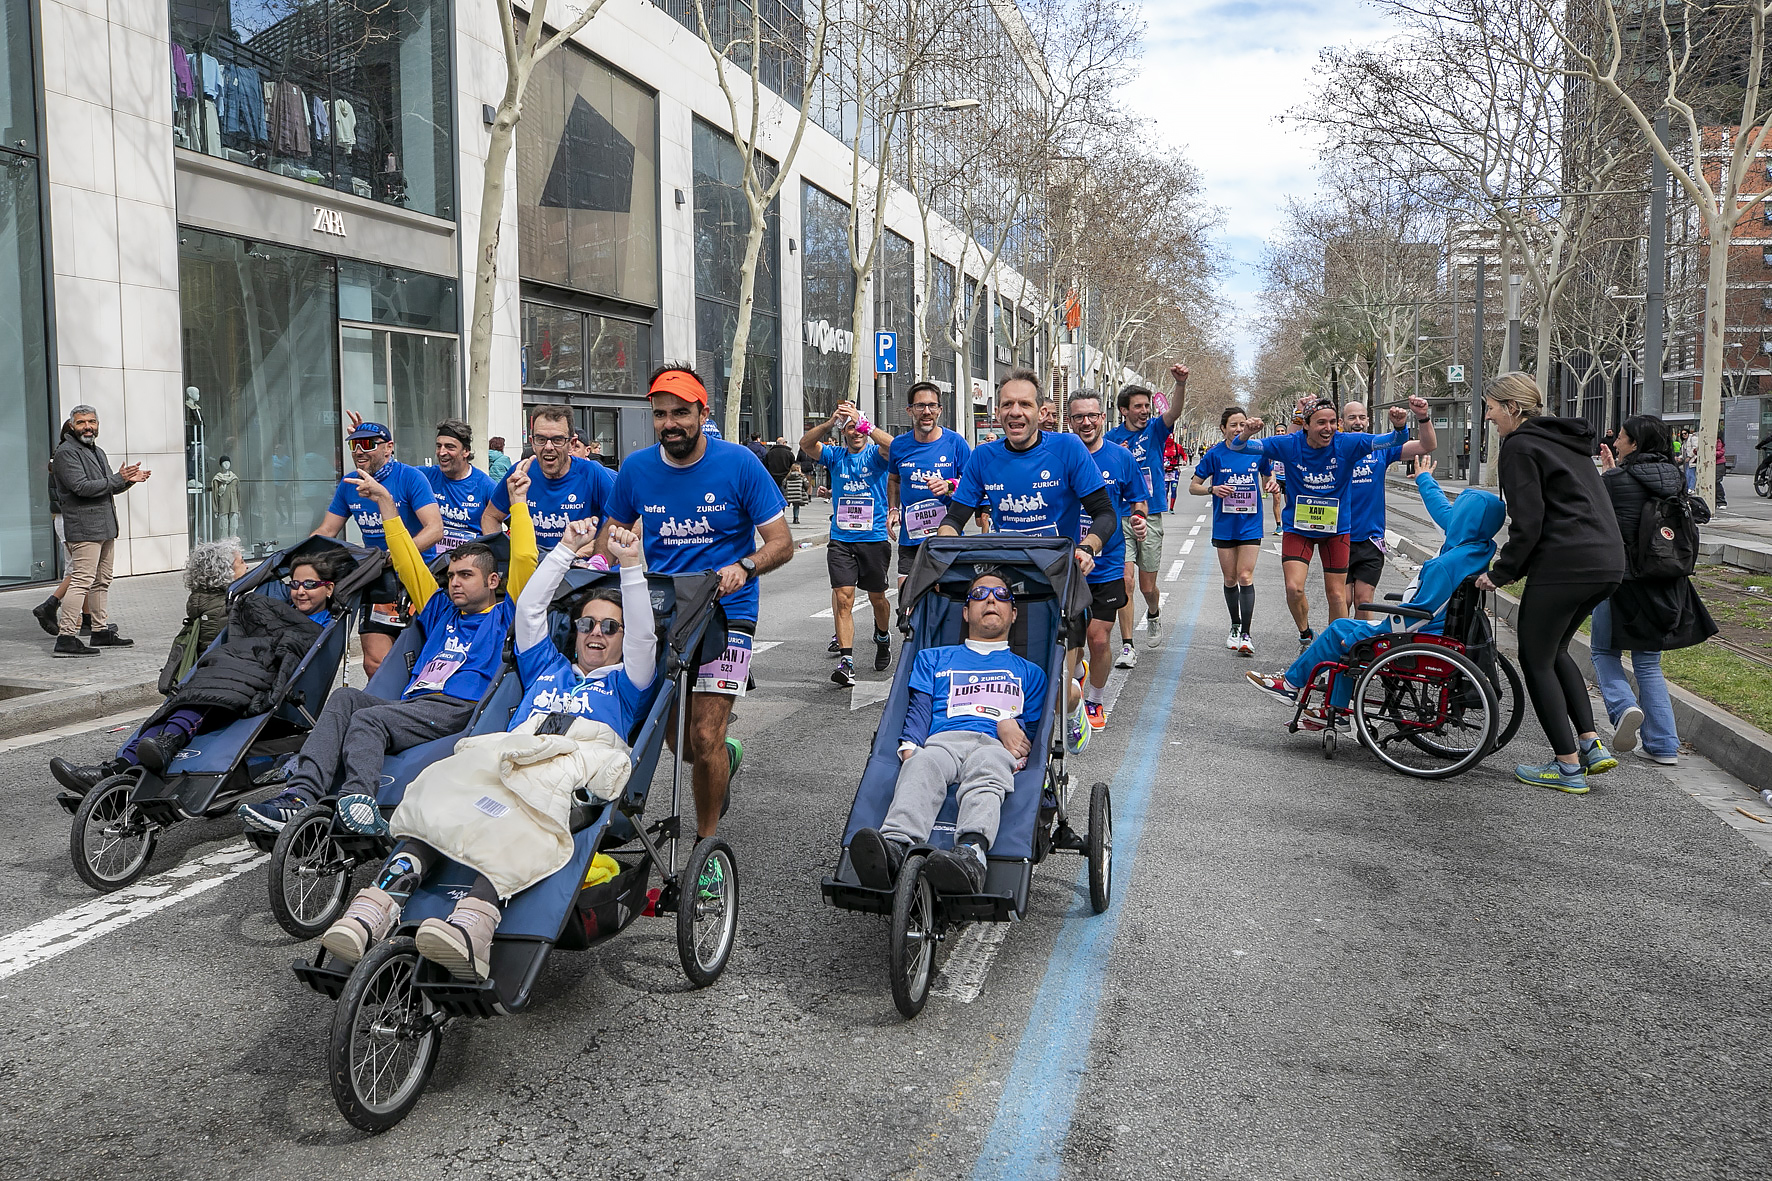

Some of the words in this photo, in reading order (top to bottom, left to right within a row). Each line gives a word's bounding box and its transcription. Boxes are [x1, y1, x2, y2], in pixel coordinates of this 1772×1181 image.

[312, 206, 347, 236] ZARA
[879, 334, 893, 357] P
[1032, 480, 1059, 489] ZURICH
[696, 504, 726, 513] ZURICH
[1308, 506, 1325, 515] XAVI
[915, 509, 937, 520] PABLO
[1002, 515, 1047, 523] #Imparables
[663, 536, 714, 546] #Imparables
[739, 651, 745, 664] J
[720, 663, 733, 673] 523
[935, 669, 951, 678] aef
[954, 682, 1020, 697] LUIS-ILLÁN
